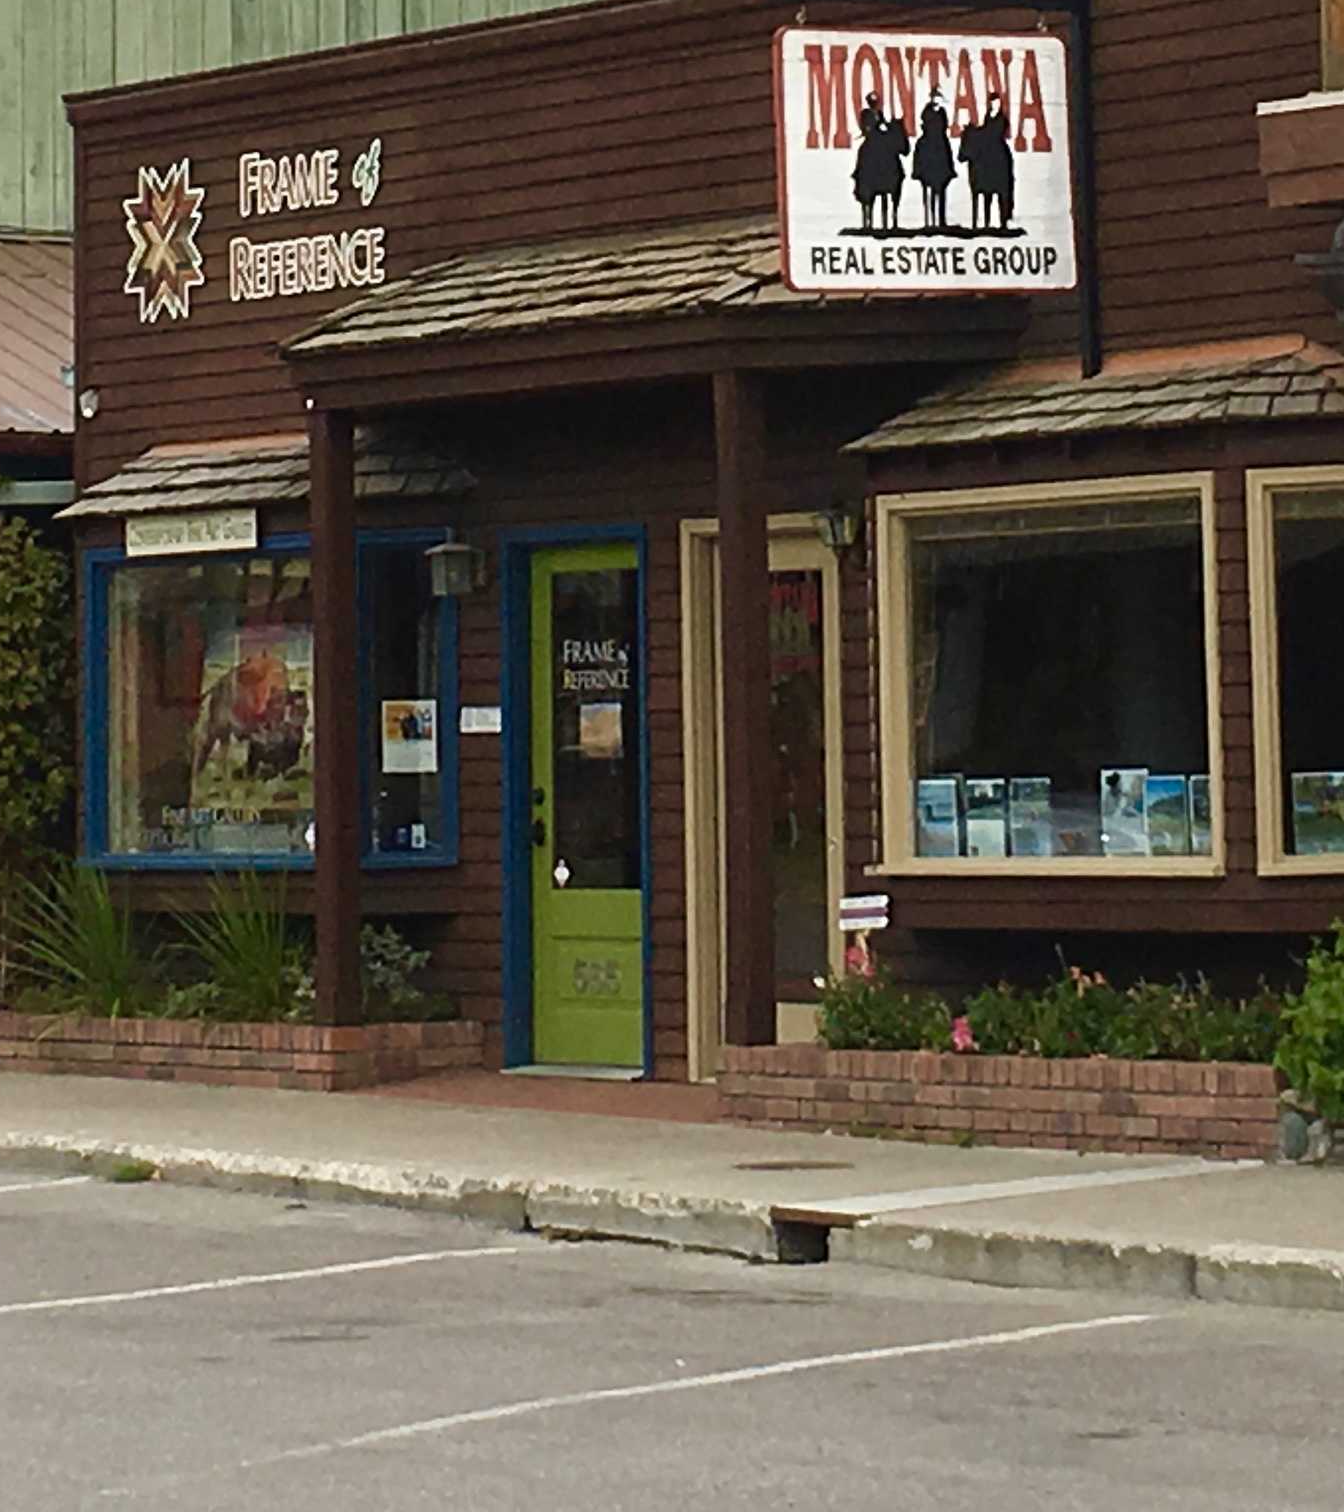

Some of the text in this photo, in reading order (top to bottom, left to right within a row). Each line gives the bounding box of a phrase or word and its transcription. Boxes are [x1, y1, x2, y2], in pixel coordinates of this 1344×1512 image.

[803, 43, 1053, 152] MONTANA
[239, 149, 339, 218] FRAME
[229, 227, 385, 301] REFERENCE
[811, 246, 1058, 276] REAL ESTATE GROUP
[562, 639, 617, 663] FRAME
